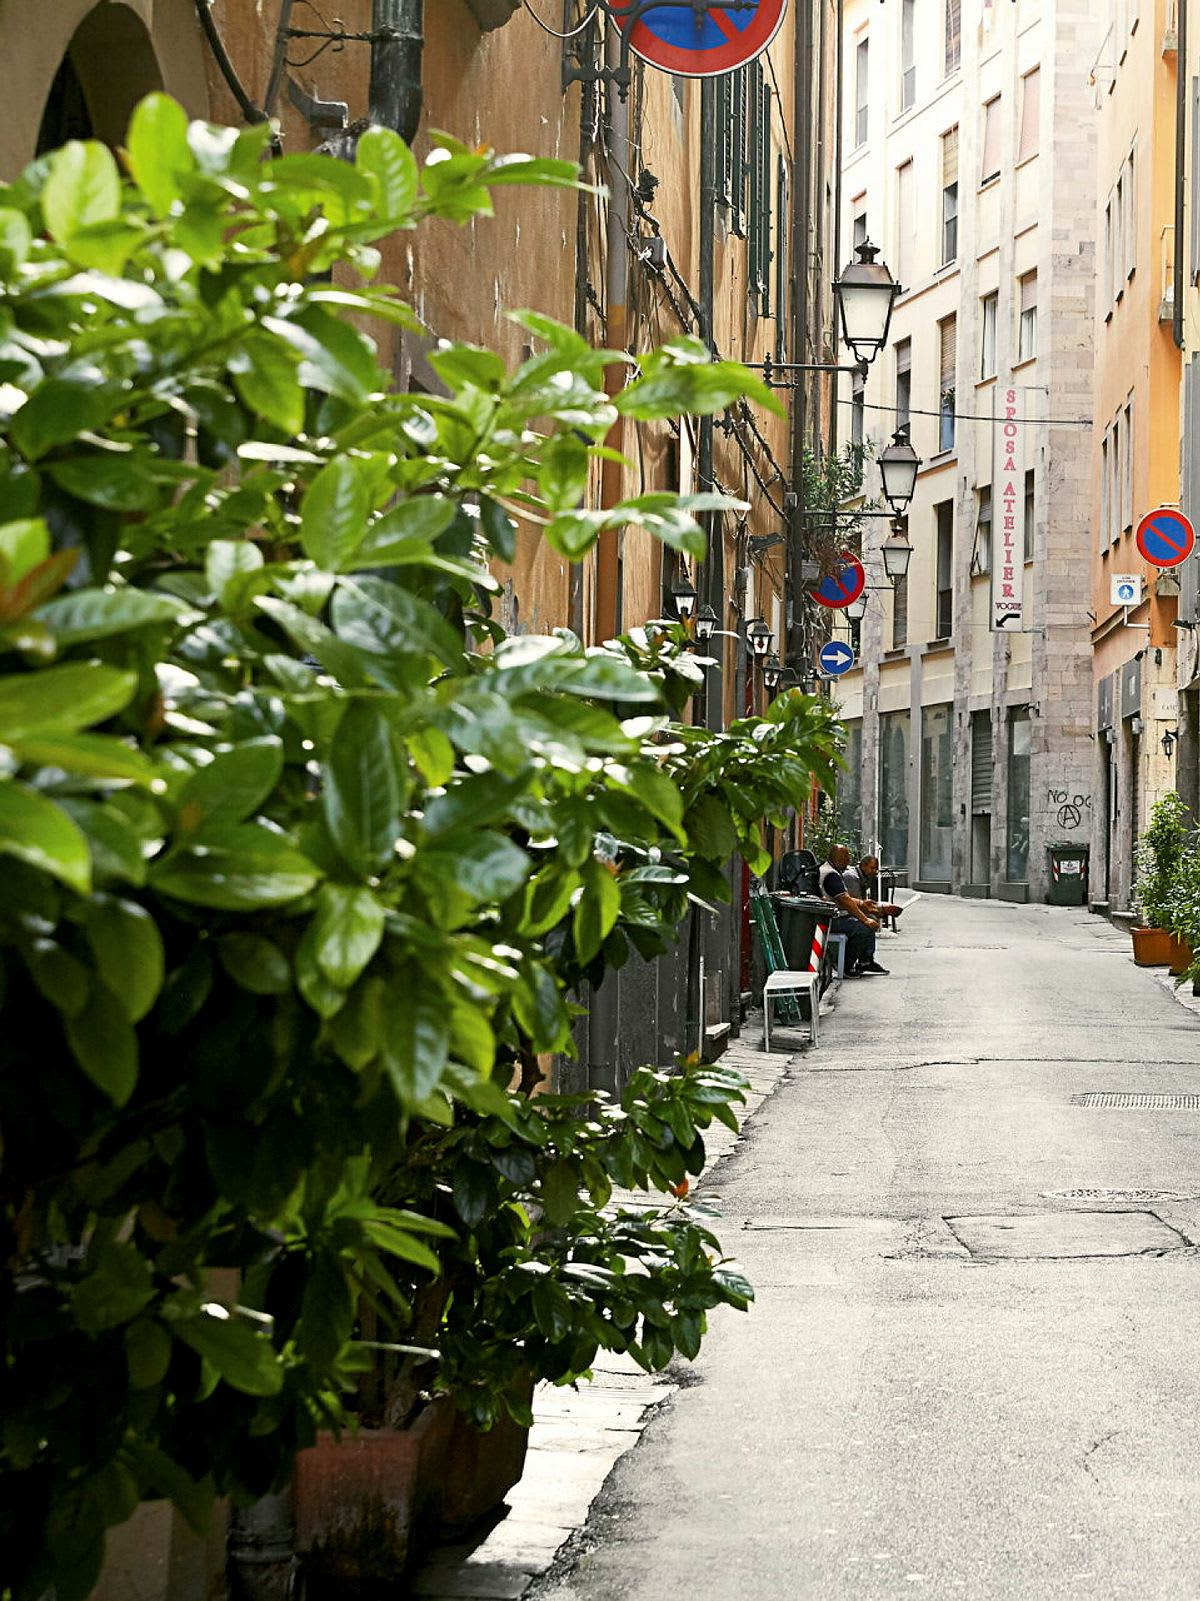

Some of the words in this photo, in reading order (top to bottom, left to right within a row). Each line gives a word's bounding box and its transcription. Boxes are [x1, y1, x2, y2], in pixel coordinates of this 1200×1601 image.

[1003, 389, 1017, 471] SPOSA
[1001, 481, 1016, 598] ATELIER
[1047, 789, 1068, 804] NO
